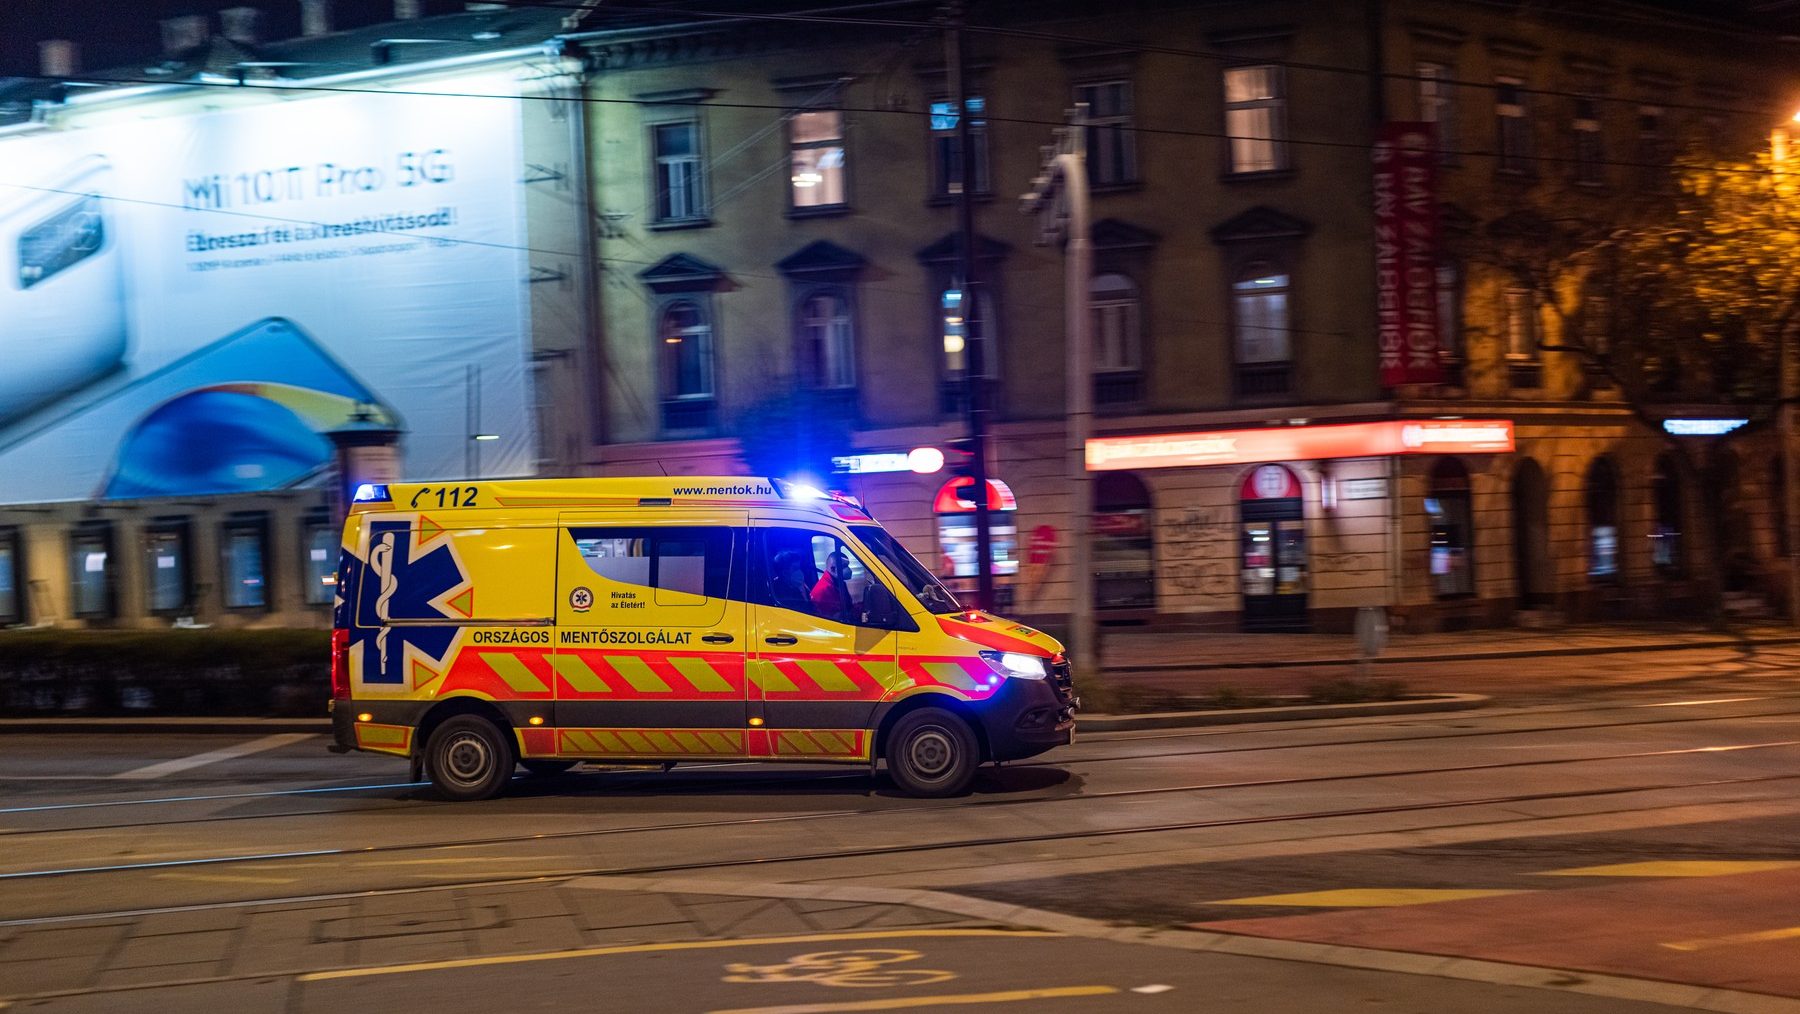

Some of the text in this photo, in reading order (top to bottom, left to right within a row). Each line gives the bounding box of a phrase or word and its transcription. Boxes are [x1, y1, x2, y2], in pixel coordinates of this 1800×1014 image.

[183, 147, 455, 209] Mi 10T Pro 5G
[435, 486, 478, 508] 112
[673, 484, 772, 496] www.mentok.hu
[611, 591, 636, 599] Hivatás
[473, 629, 692, 645] ORSZÁGOS MENTŐSZOLGÁLAT
